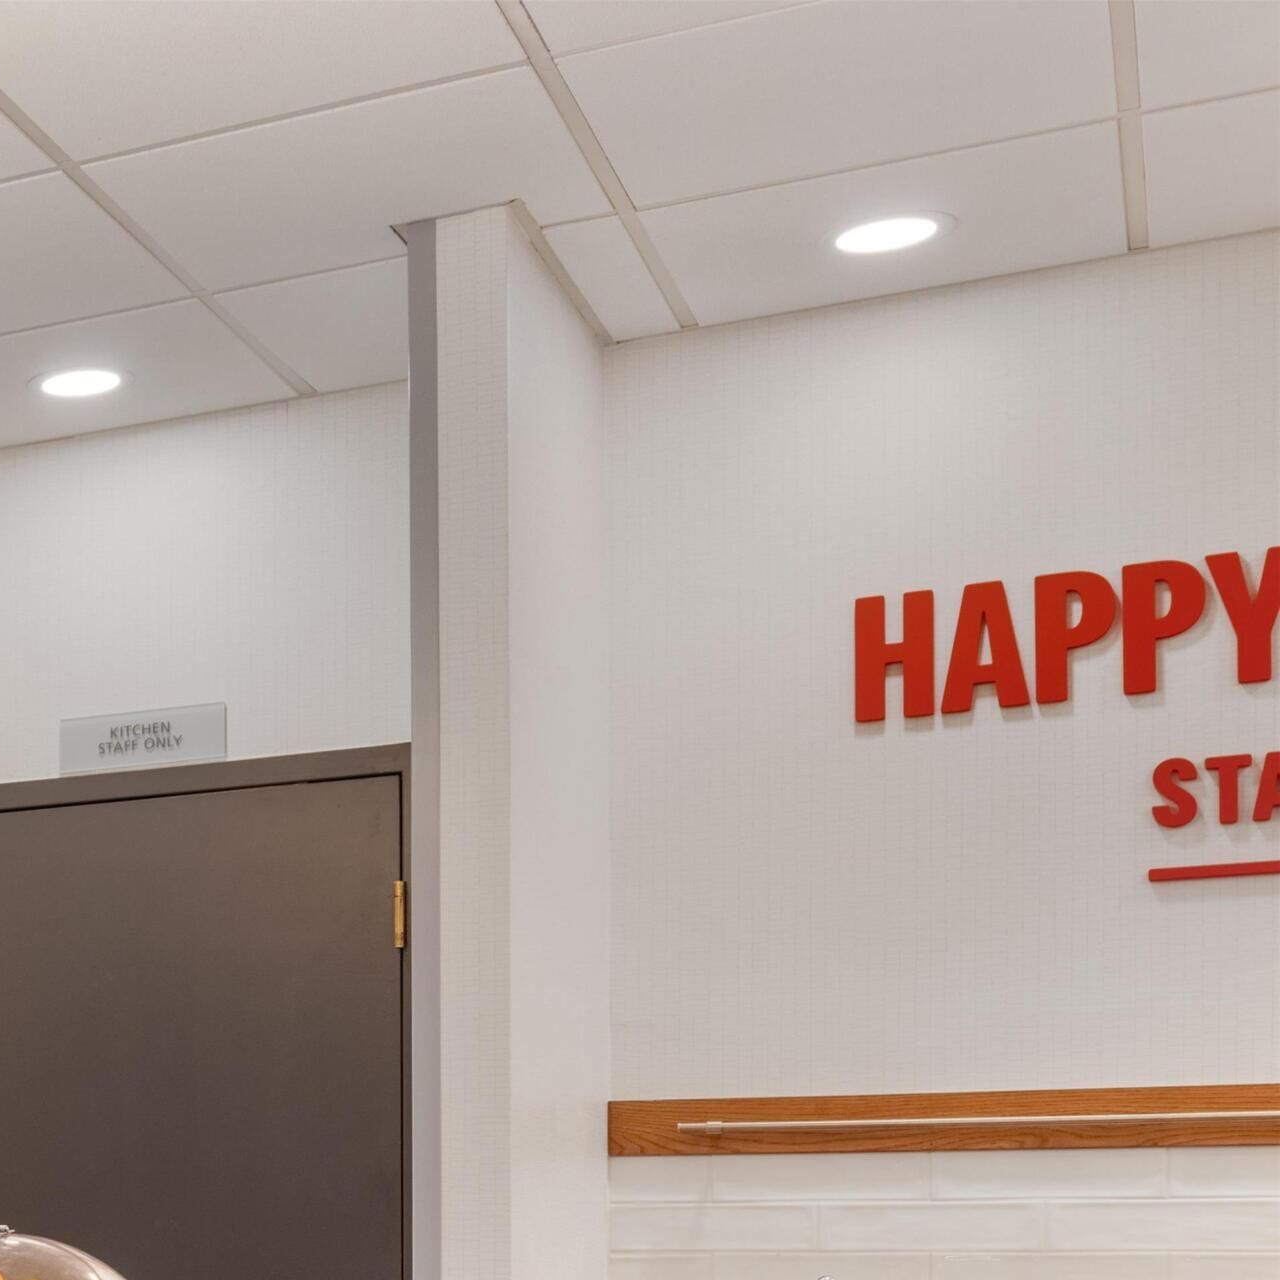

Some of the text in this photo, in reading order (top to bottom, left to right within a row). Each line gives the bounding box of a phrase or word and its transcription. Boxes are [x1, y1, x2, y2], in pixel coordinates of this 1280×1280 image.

[855, 547, 1280, 723] HAPPY
[110, 721, 171, 739] KITCHEN
[98, 735, 183, 755] STAFF ONLY
